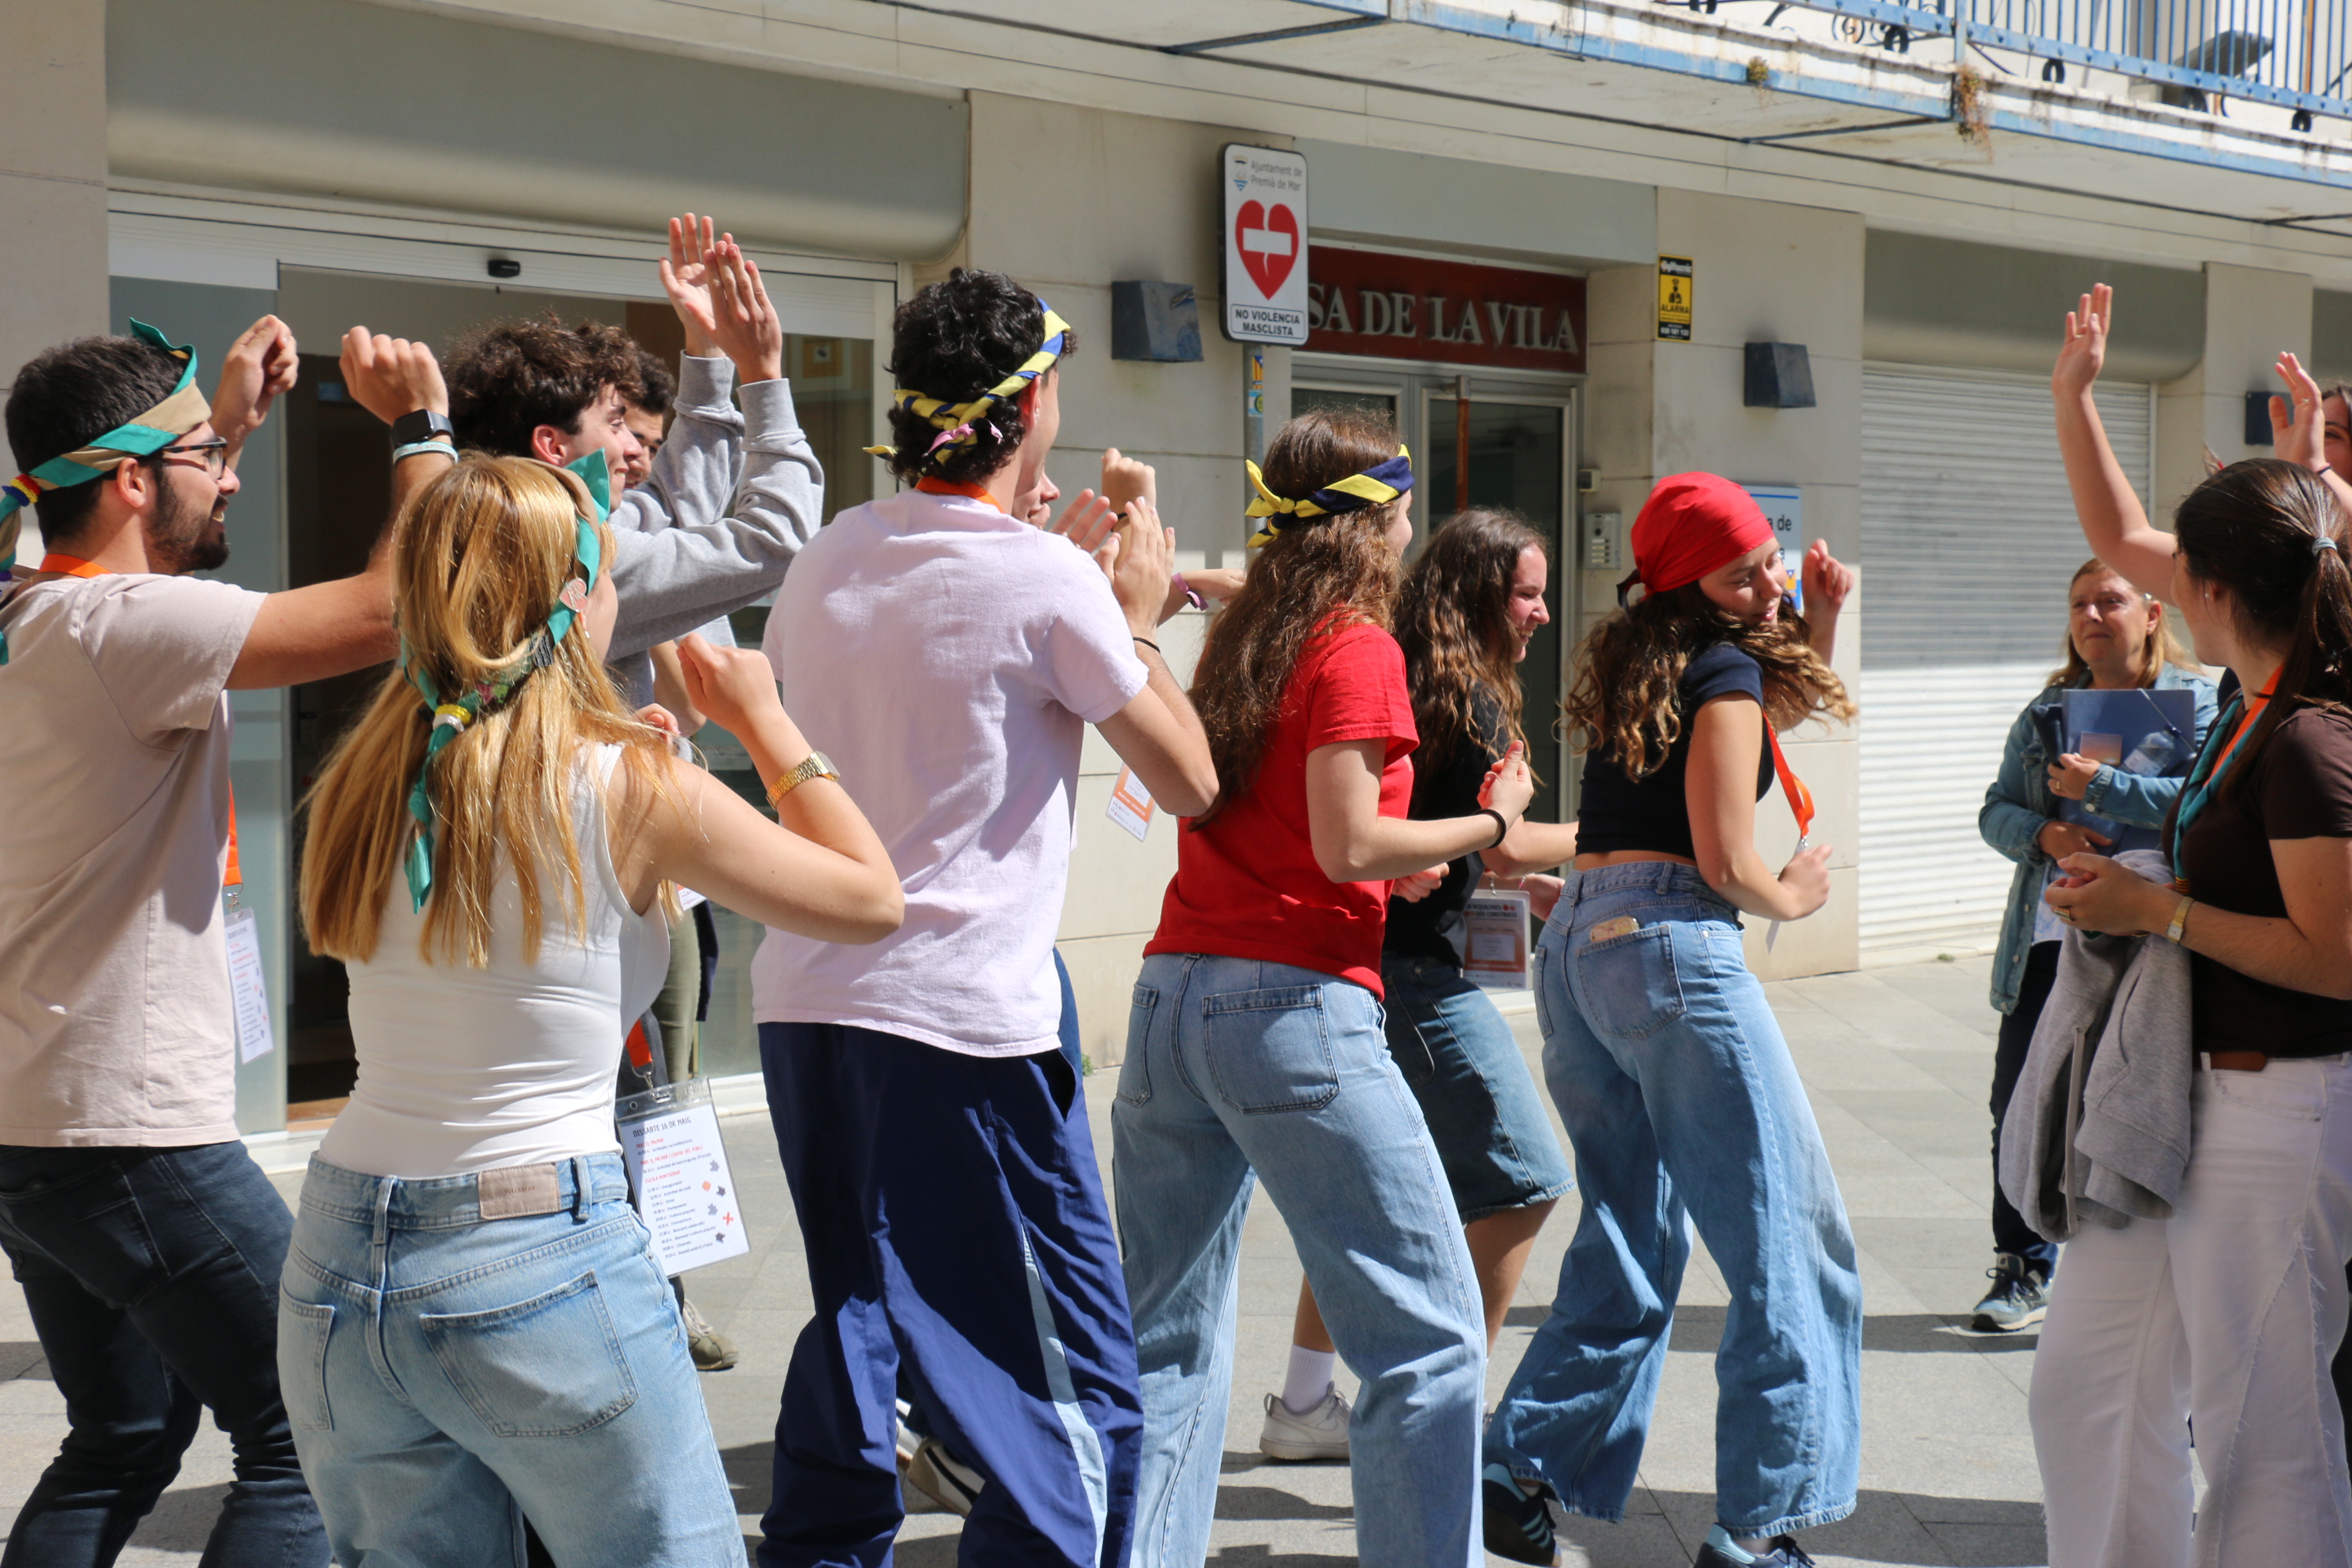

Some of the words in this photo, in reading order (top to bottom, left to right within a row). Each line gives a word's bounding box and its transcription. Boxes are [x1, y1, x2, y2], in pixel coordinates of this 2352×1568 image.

[1250, 160, 1291, 176] Ajuntament
[1293, 166, 1302, 177] de
[1251, 175, 1275, 188] Premià
[1278, 177, 1286, 190] de
[1288, 178, 1301, 191] Mar
[1235, 308, 1249, 320] NO
[1252, 310, 1300, 324] VIOLÈNCIA
[1358, 290, 1416, 338] DE
[1661, 304, 1689, 313] ALARMA
[1242, 322, 1293, 336] MASCLISTA
[1778, 514, 1792, 531] de
[632, 1124, 660, 1137] DISSABTE
[660, 1122, 668, 1130] 16
[677, 1116, 691, 1126] MAIG
[658, 1170, 681, 1179] MONTSERRAT
